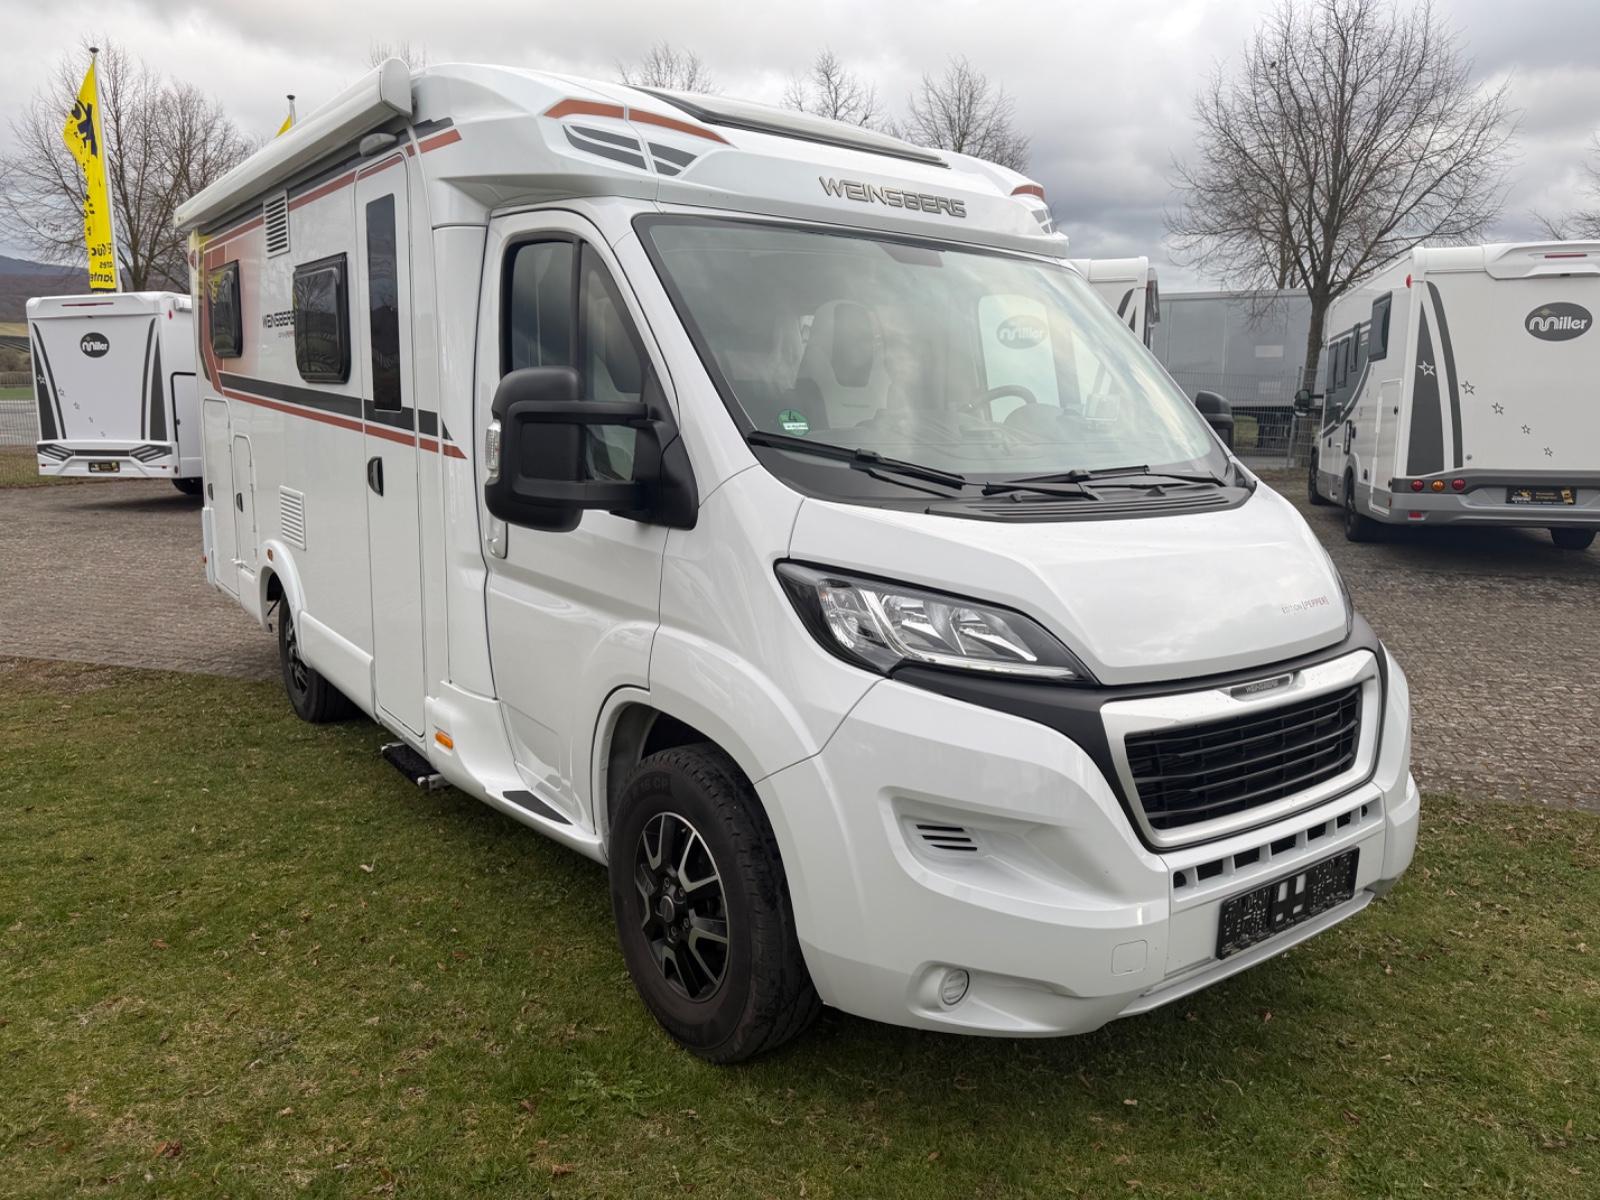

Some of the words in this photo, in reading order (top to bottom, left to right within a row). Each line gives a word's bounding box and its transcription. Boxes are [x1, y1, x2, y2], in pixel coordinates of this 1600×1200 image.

[818, 175, 967, 218] WEINSBERG
[1529, 315, 1588, 332] Miller
[82, 341, 108, 352] Miller
